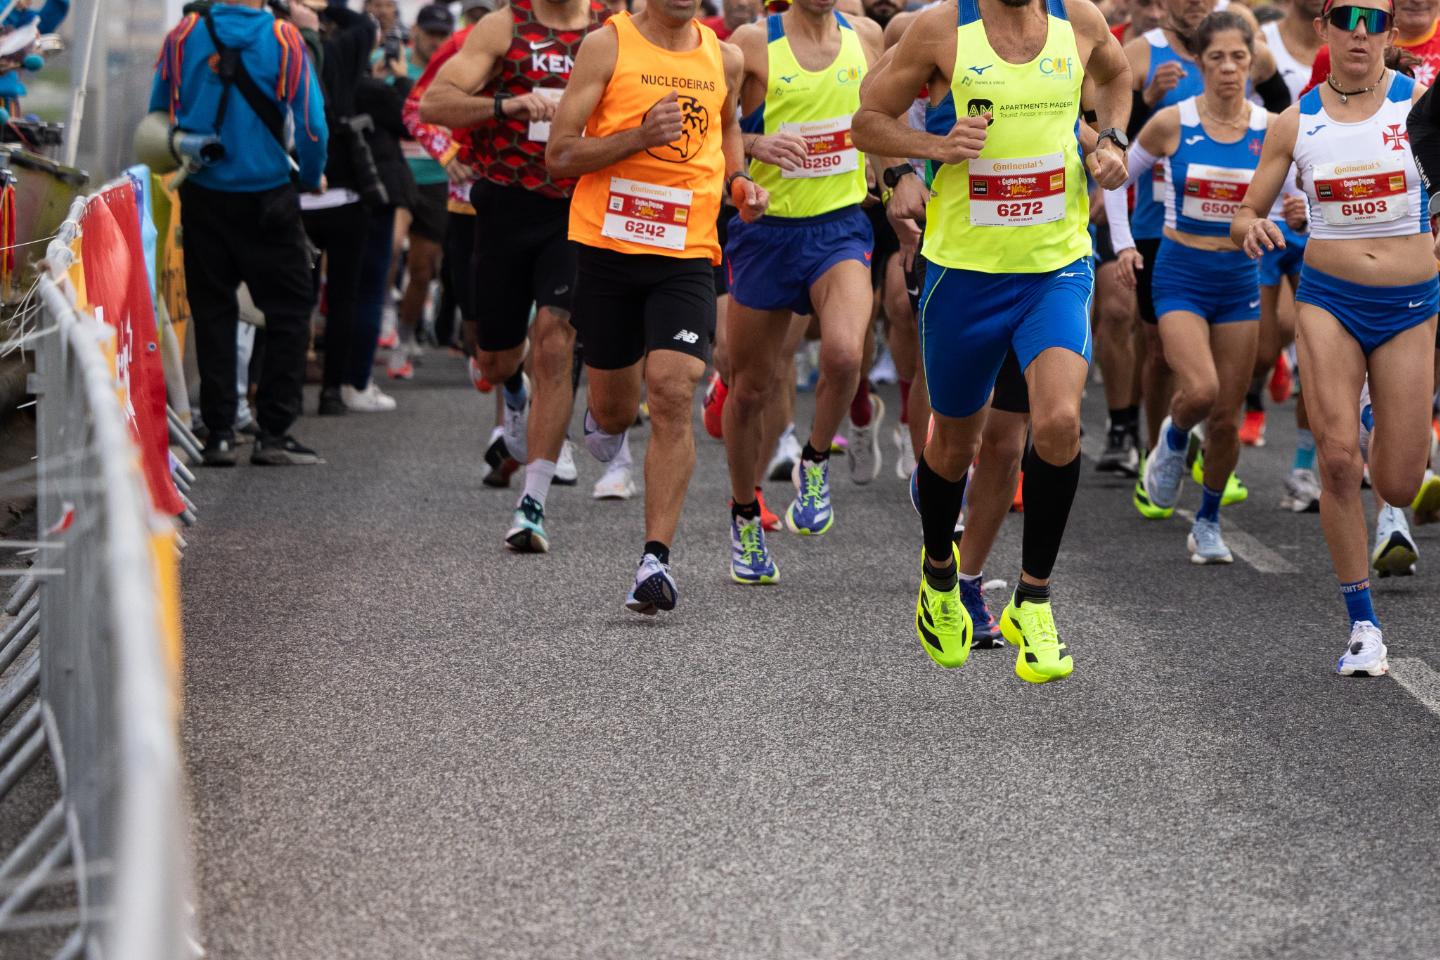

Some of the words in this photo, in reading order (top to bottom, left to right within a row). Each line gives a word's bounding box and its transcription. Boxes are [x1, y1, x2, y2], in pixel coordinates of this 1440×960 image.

[641, 73, 715, 92] NUCLEOEIRAS
[1000, 102, 1048, 111] APARTMENTS
[802, 154, 842, 169] 6280
[992, 160, 1038, 173] Continental
[997, 201, 1043, 217] 6272
[1341, 200, 1388, 217] 6403
[624, 220, 666, 238] 6242
